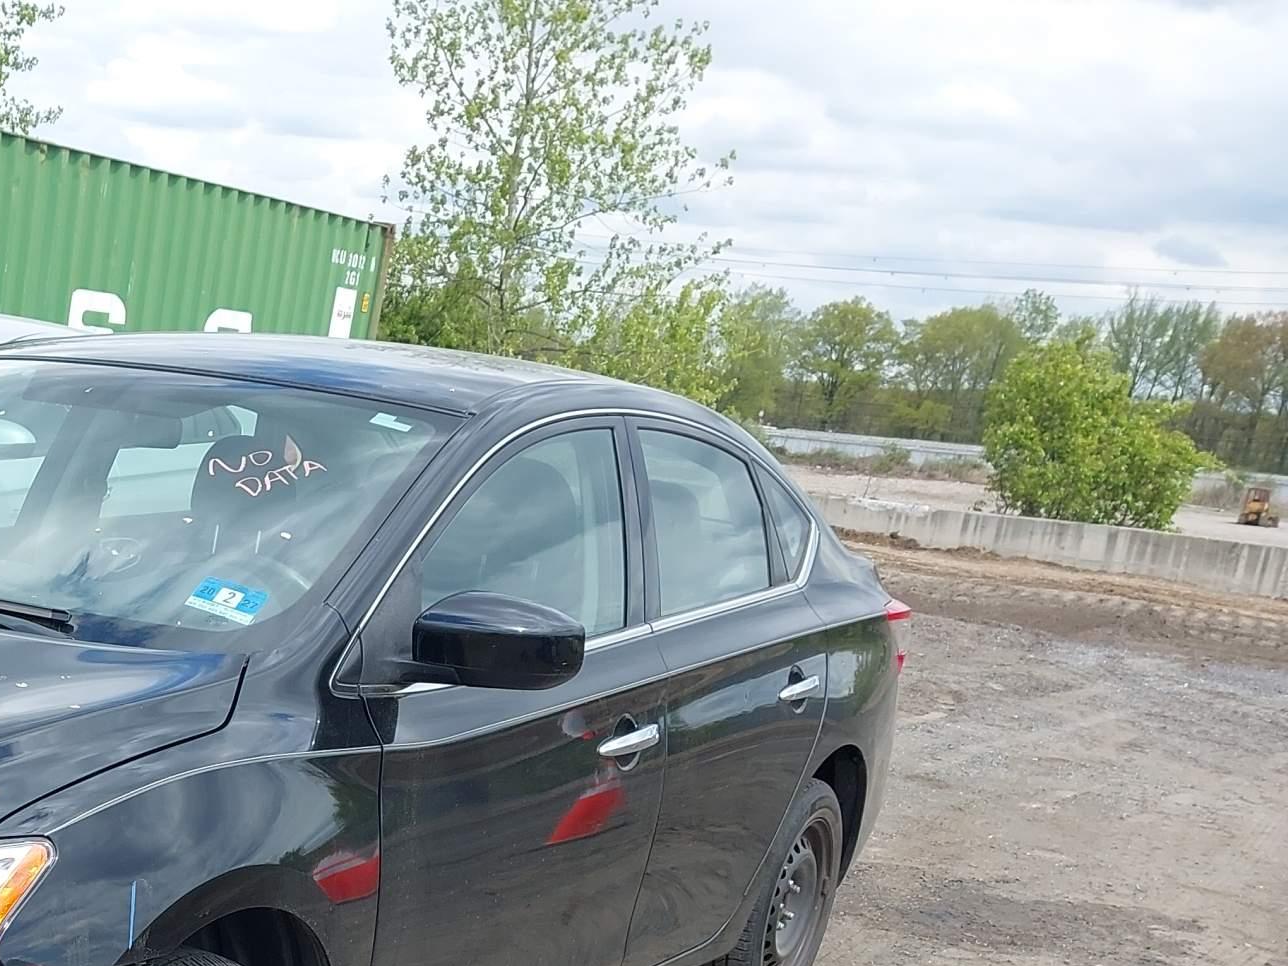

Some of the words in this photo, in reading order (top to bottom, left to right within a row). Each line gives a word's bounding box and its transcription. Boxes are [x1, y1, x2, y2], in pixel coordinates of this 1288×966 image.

[208, 450, 273, 476] NO
[235, 460, 328, 497] DATA
[223, 591, 237, 605] 2
